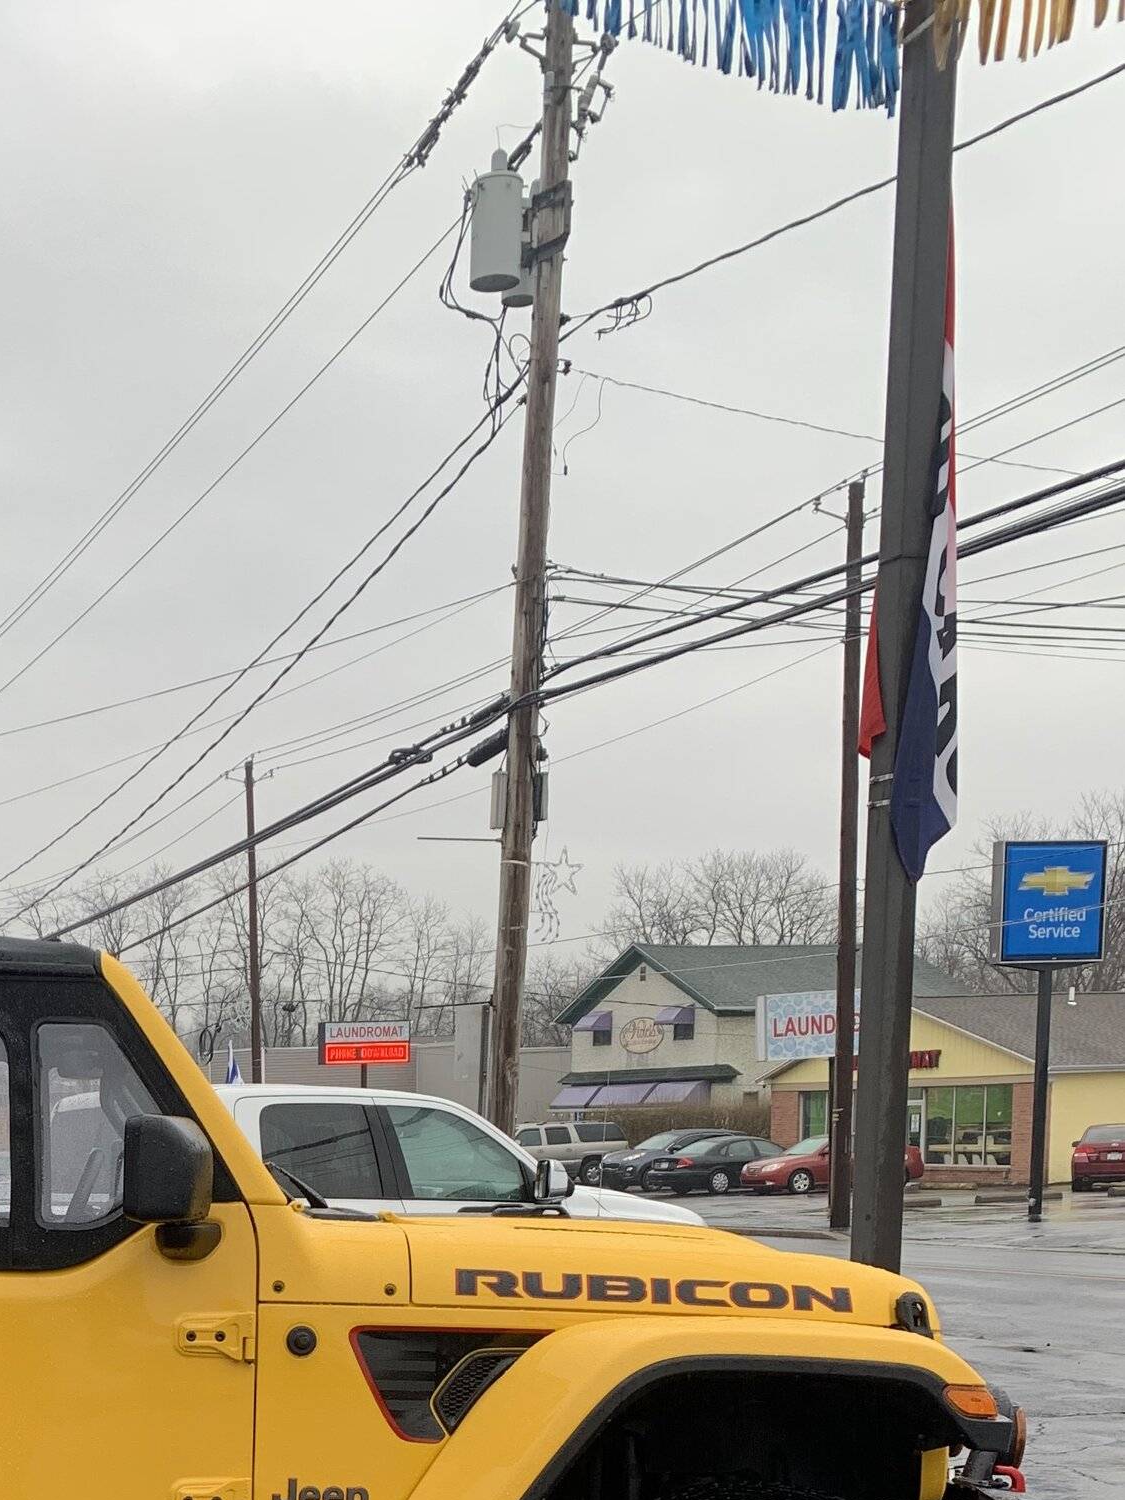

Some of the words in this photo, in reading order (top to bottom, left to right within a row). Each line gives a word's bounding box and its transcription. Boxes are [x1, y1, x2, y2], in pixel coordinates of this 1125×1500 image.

[1024, 907, 1086, 922] Certified
[1028, 924, 1081, 939] Service
[330, 1026, 404, 1038] LAUNDROMAT
[772, 1013, 860, 1038] LAUND
[455, 1268, 854, 1313] RUBICON
